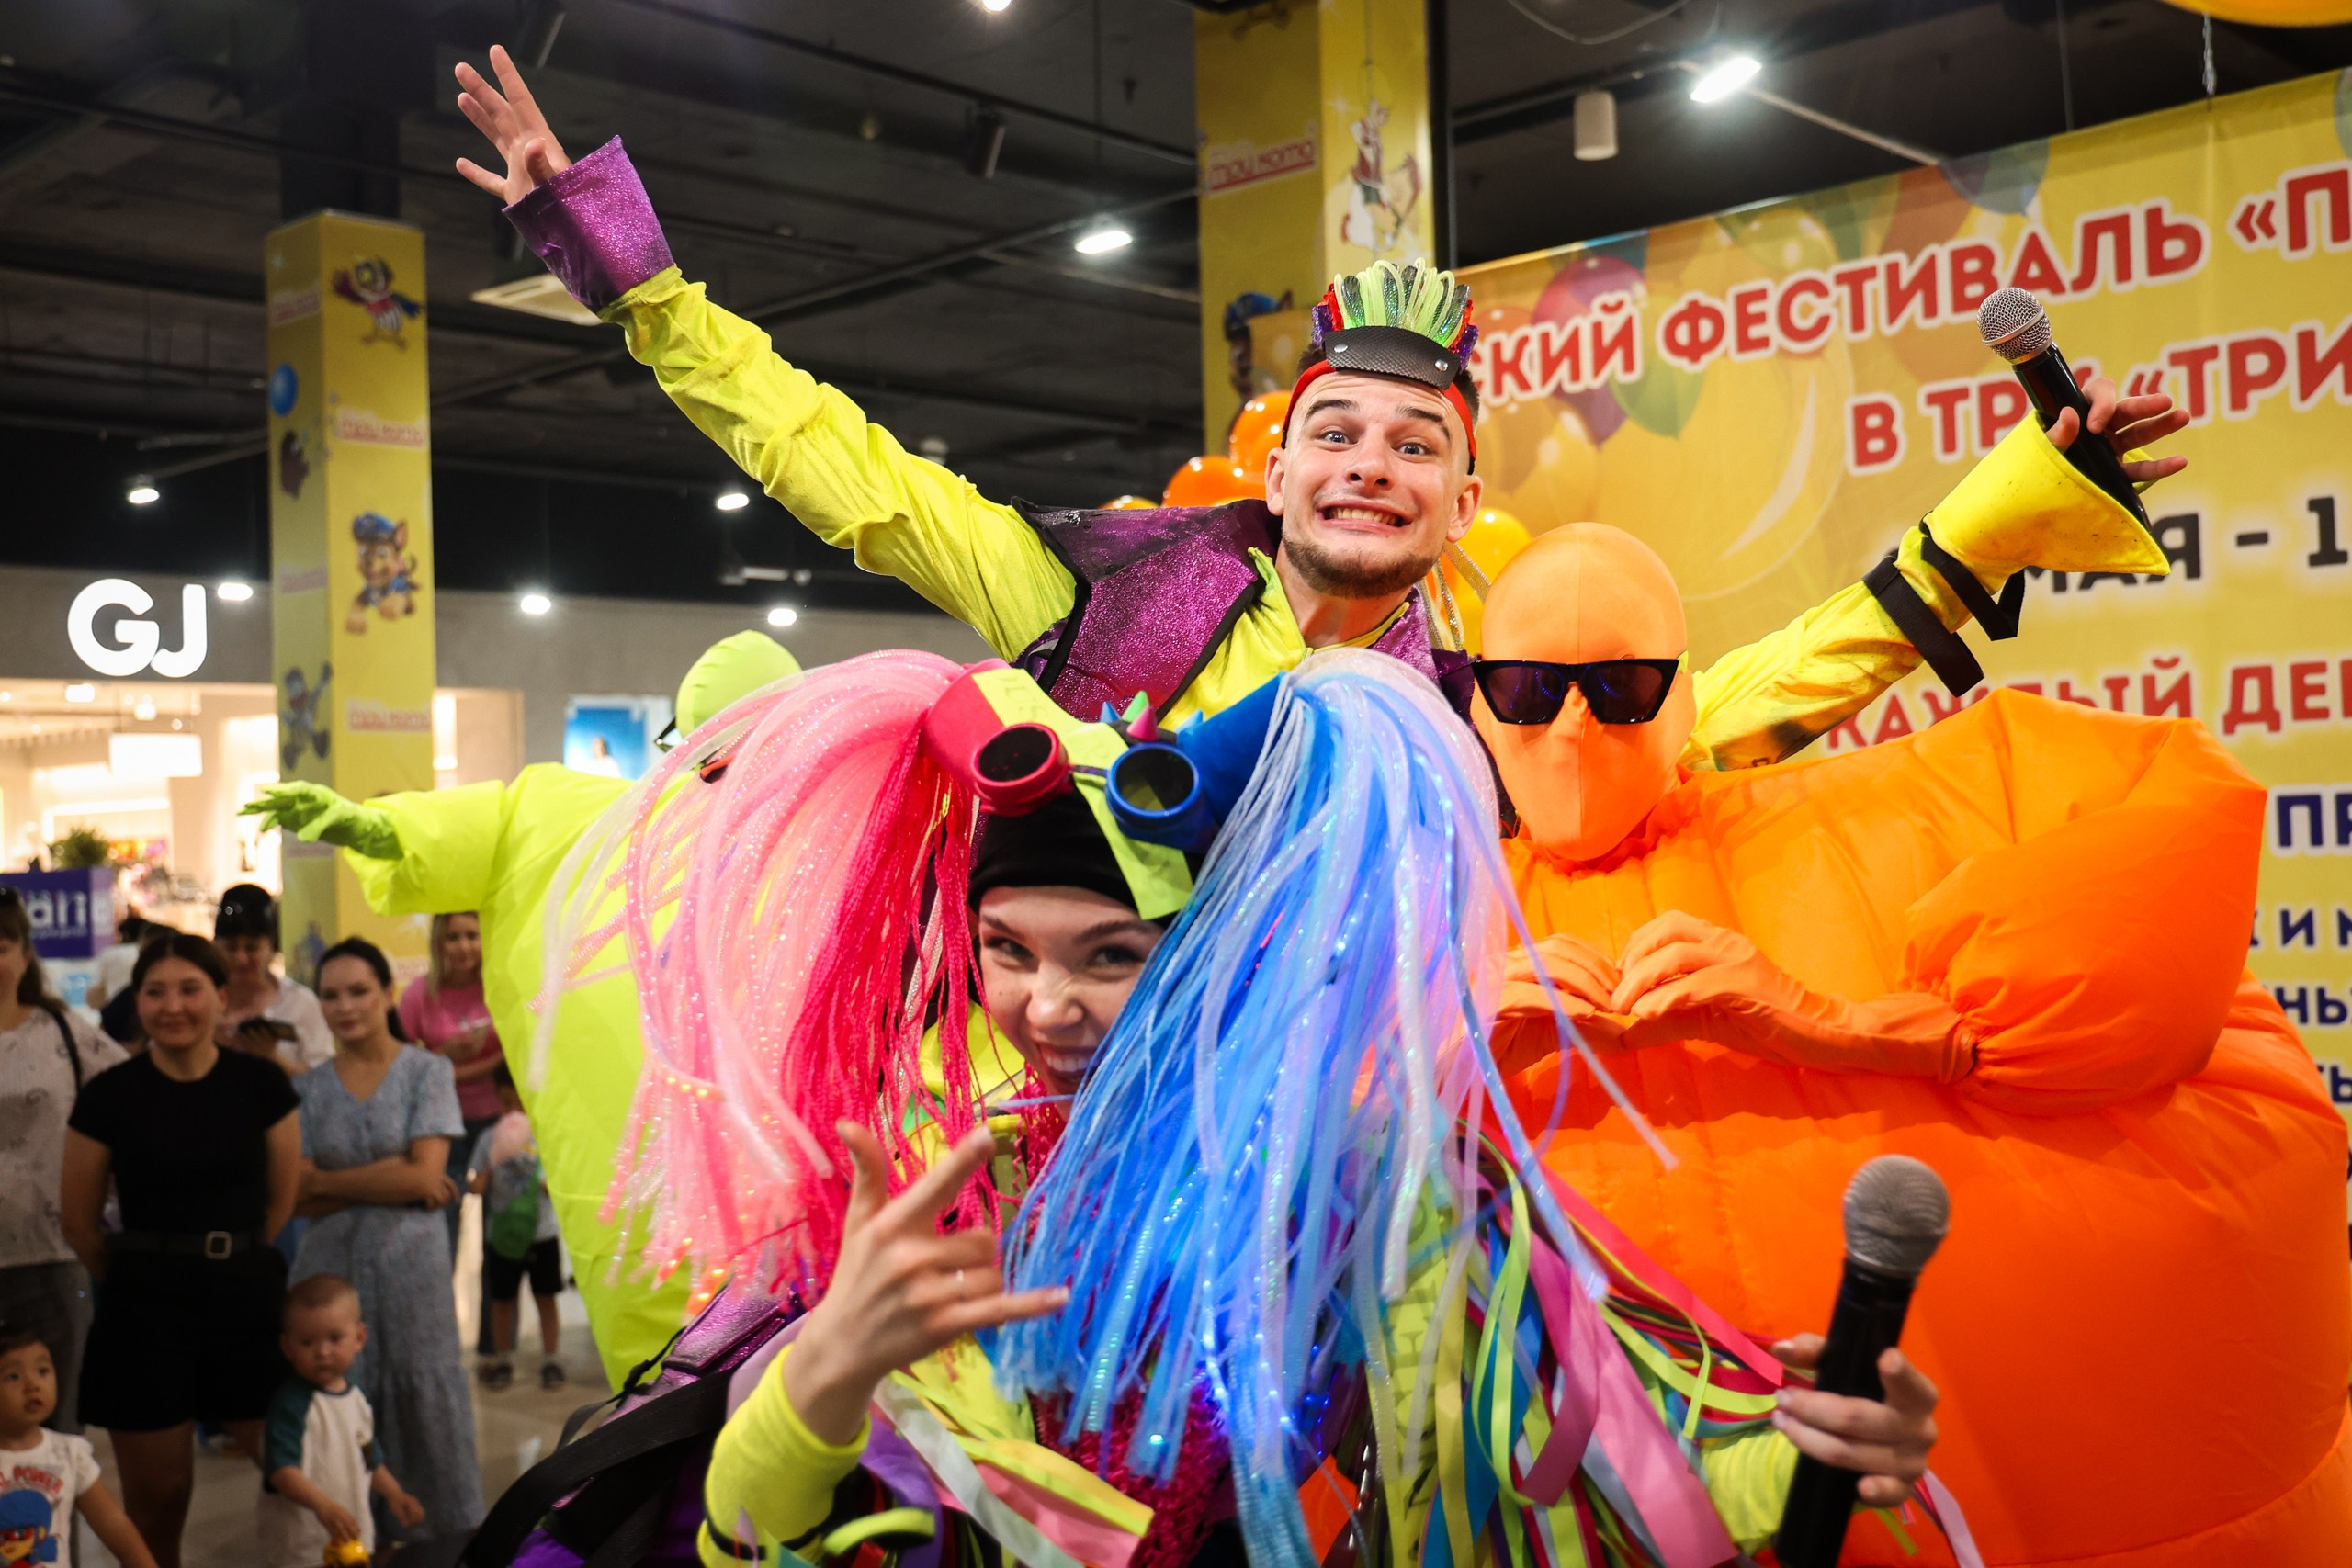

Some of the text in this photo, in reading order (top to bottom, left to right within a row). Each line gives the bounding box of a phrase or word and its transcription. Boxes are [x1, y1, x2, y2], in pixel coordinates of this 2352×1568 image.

[1471, 299, 1635, 397] КИЙ
[1663, 207, 2203, 364] ФЕСТИВАЛЬ
[1852, 401, 1898, 468] В
[1926, 367, 2093, 455] ТР
[68, 578, 207, 678] GJ
